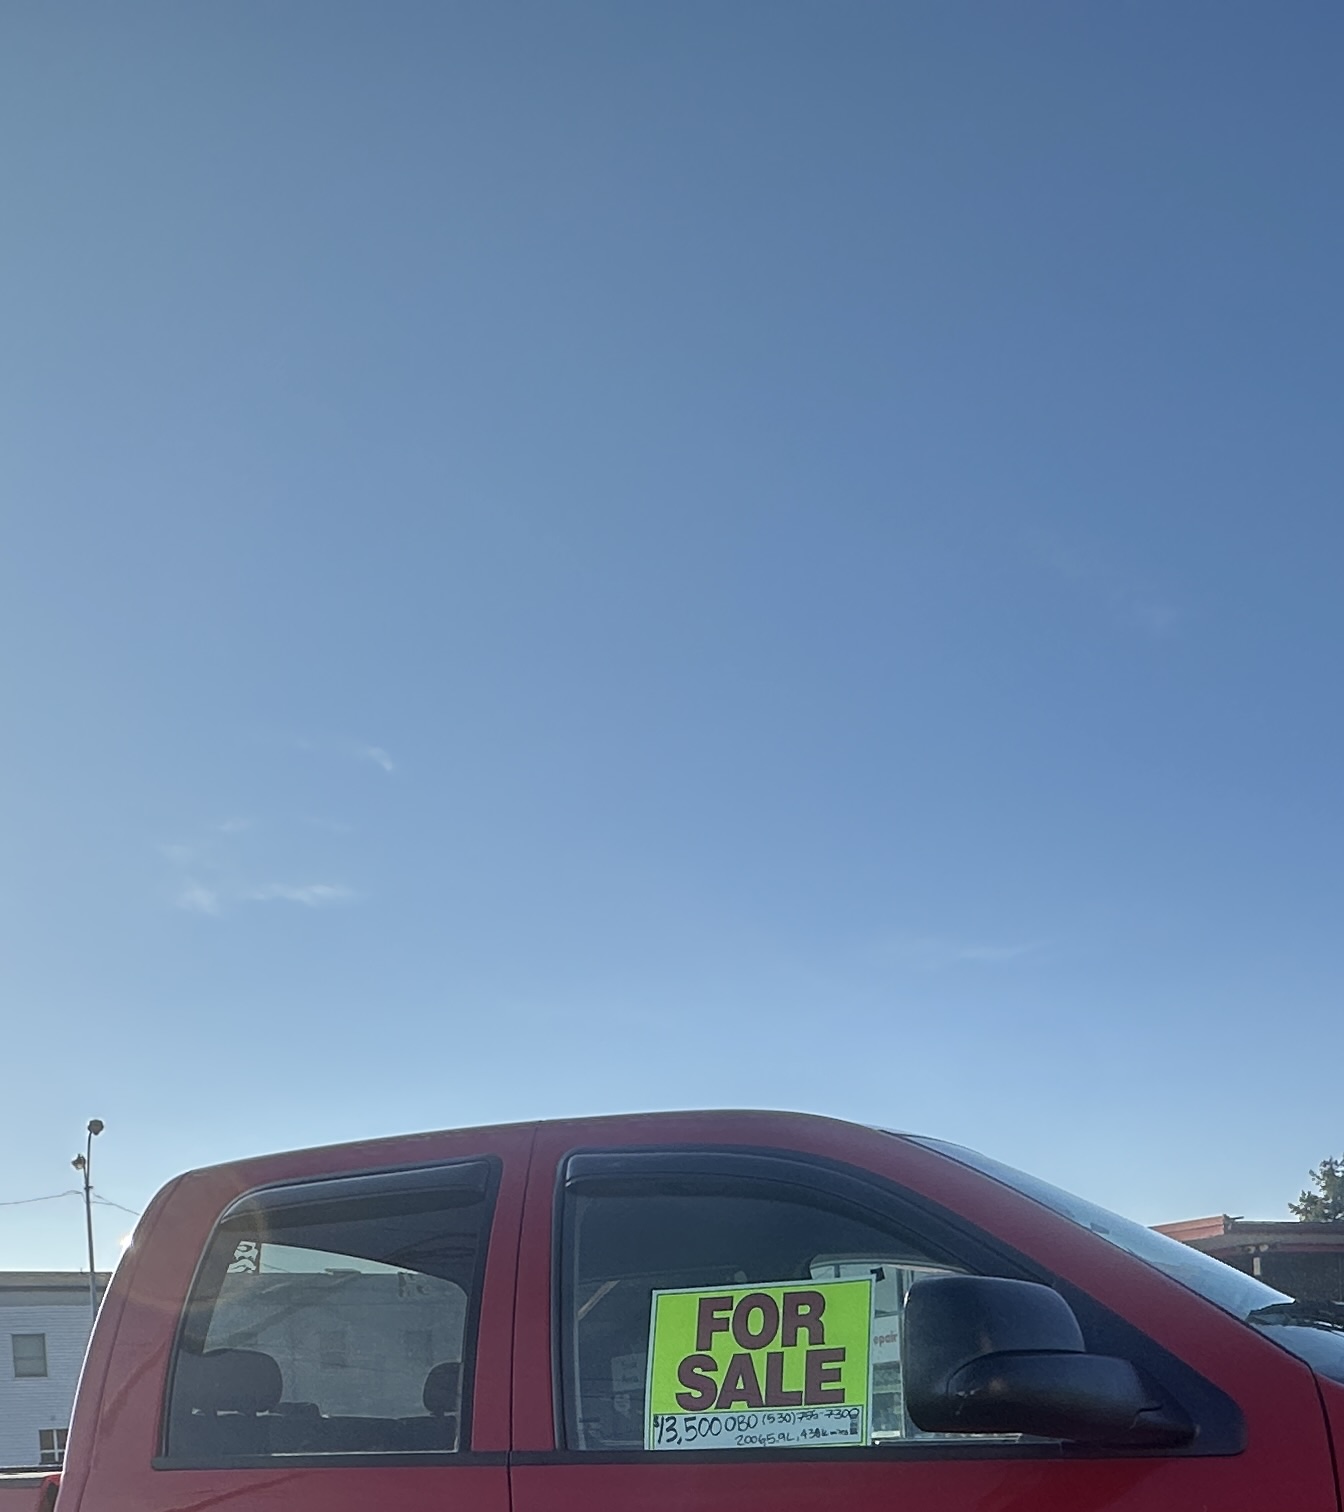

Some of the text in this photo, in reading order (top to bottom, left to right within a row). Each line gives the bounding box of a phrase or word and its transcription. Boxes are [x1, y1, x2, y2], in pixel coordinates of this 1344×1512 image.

[695, 1290, 826, 1352] FOR
[675, 1347, 847, 1412] SALE
[653, 1414, 723, 1446] $13,500
[724, 1413, 759, 1432] OBO
